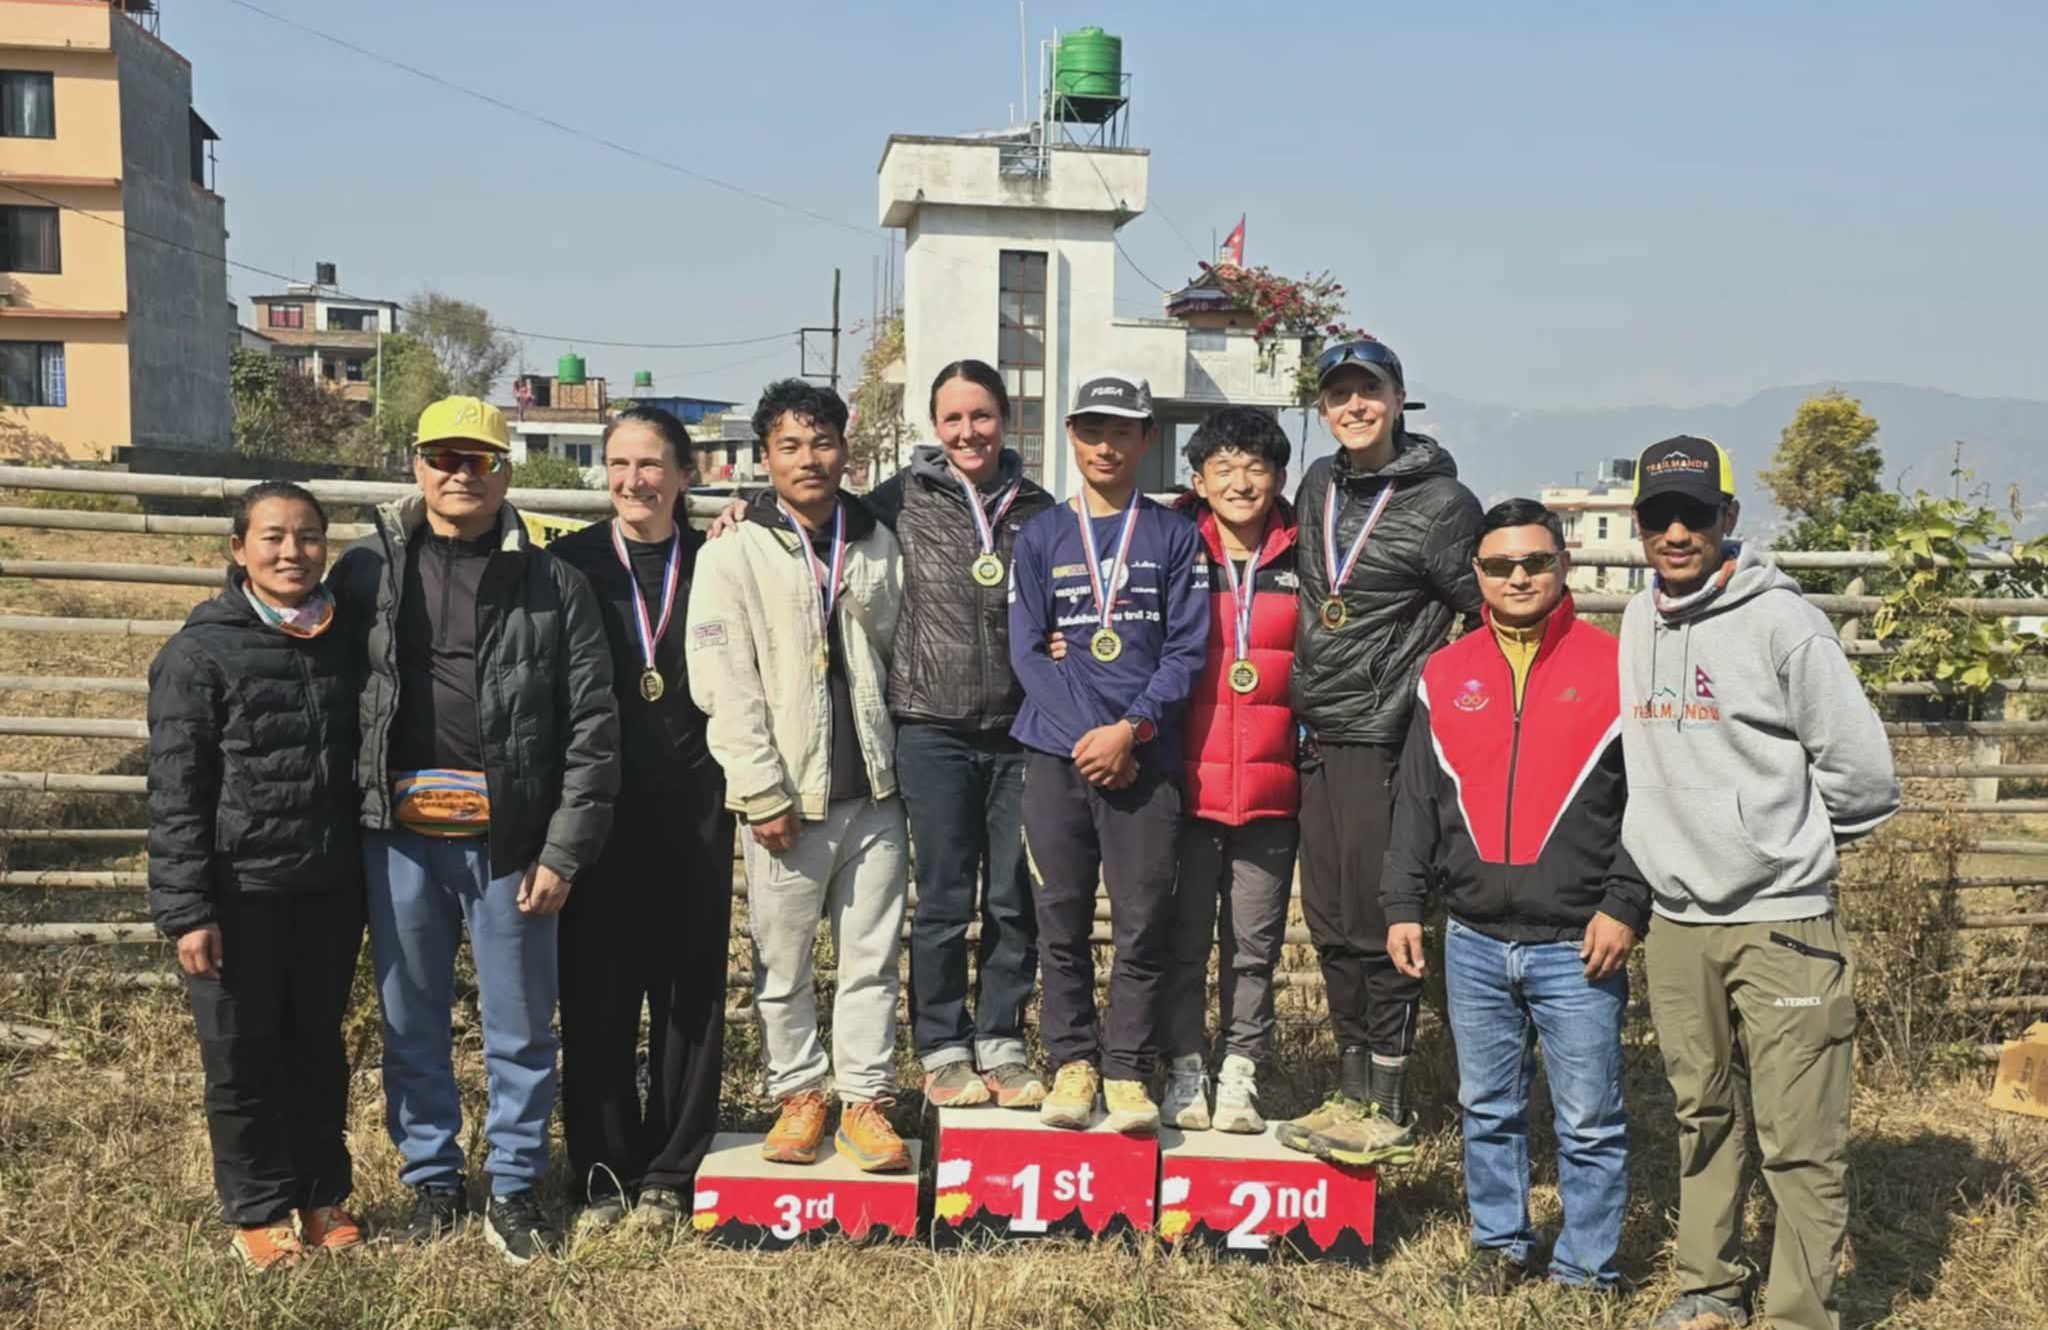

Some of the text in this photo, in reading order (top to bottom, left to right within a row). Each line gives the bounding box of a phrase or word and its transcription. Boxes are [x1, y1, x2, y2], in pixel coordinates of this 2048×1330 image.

[771, 1193, 835, 1241] 3rd
[1009, 1162, 1095, 1232] 1st
[1227, 1179, 1327, 1249] 2nd
